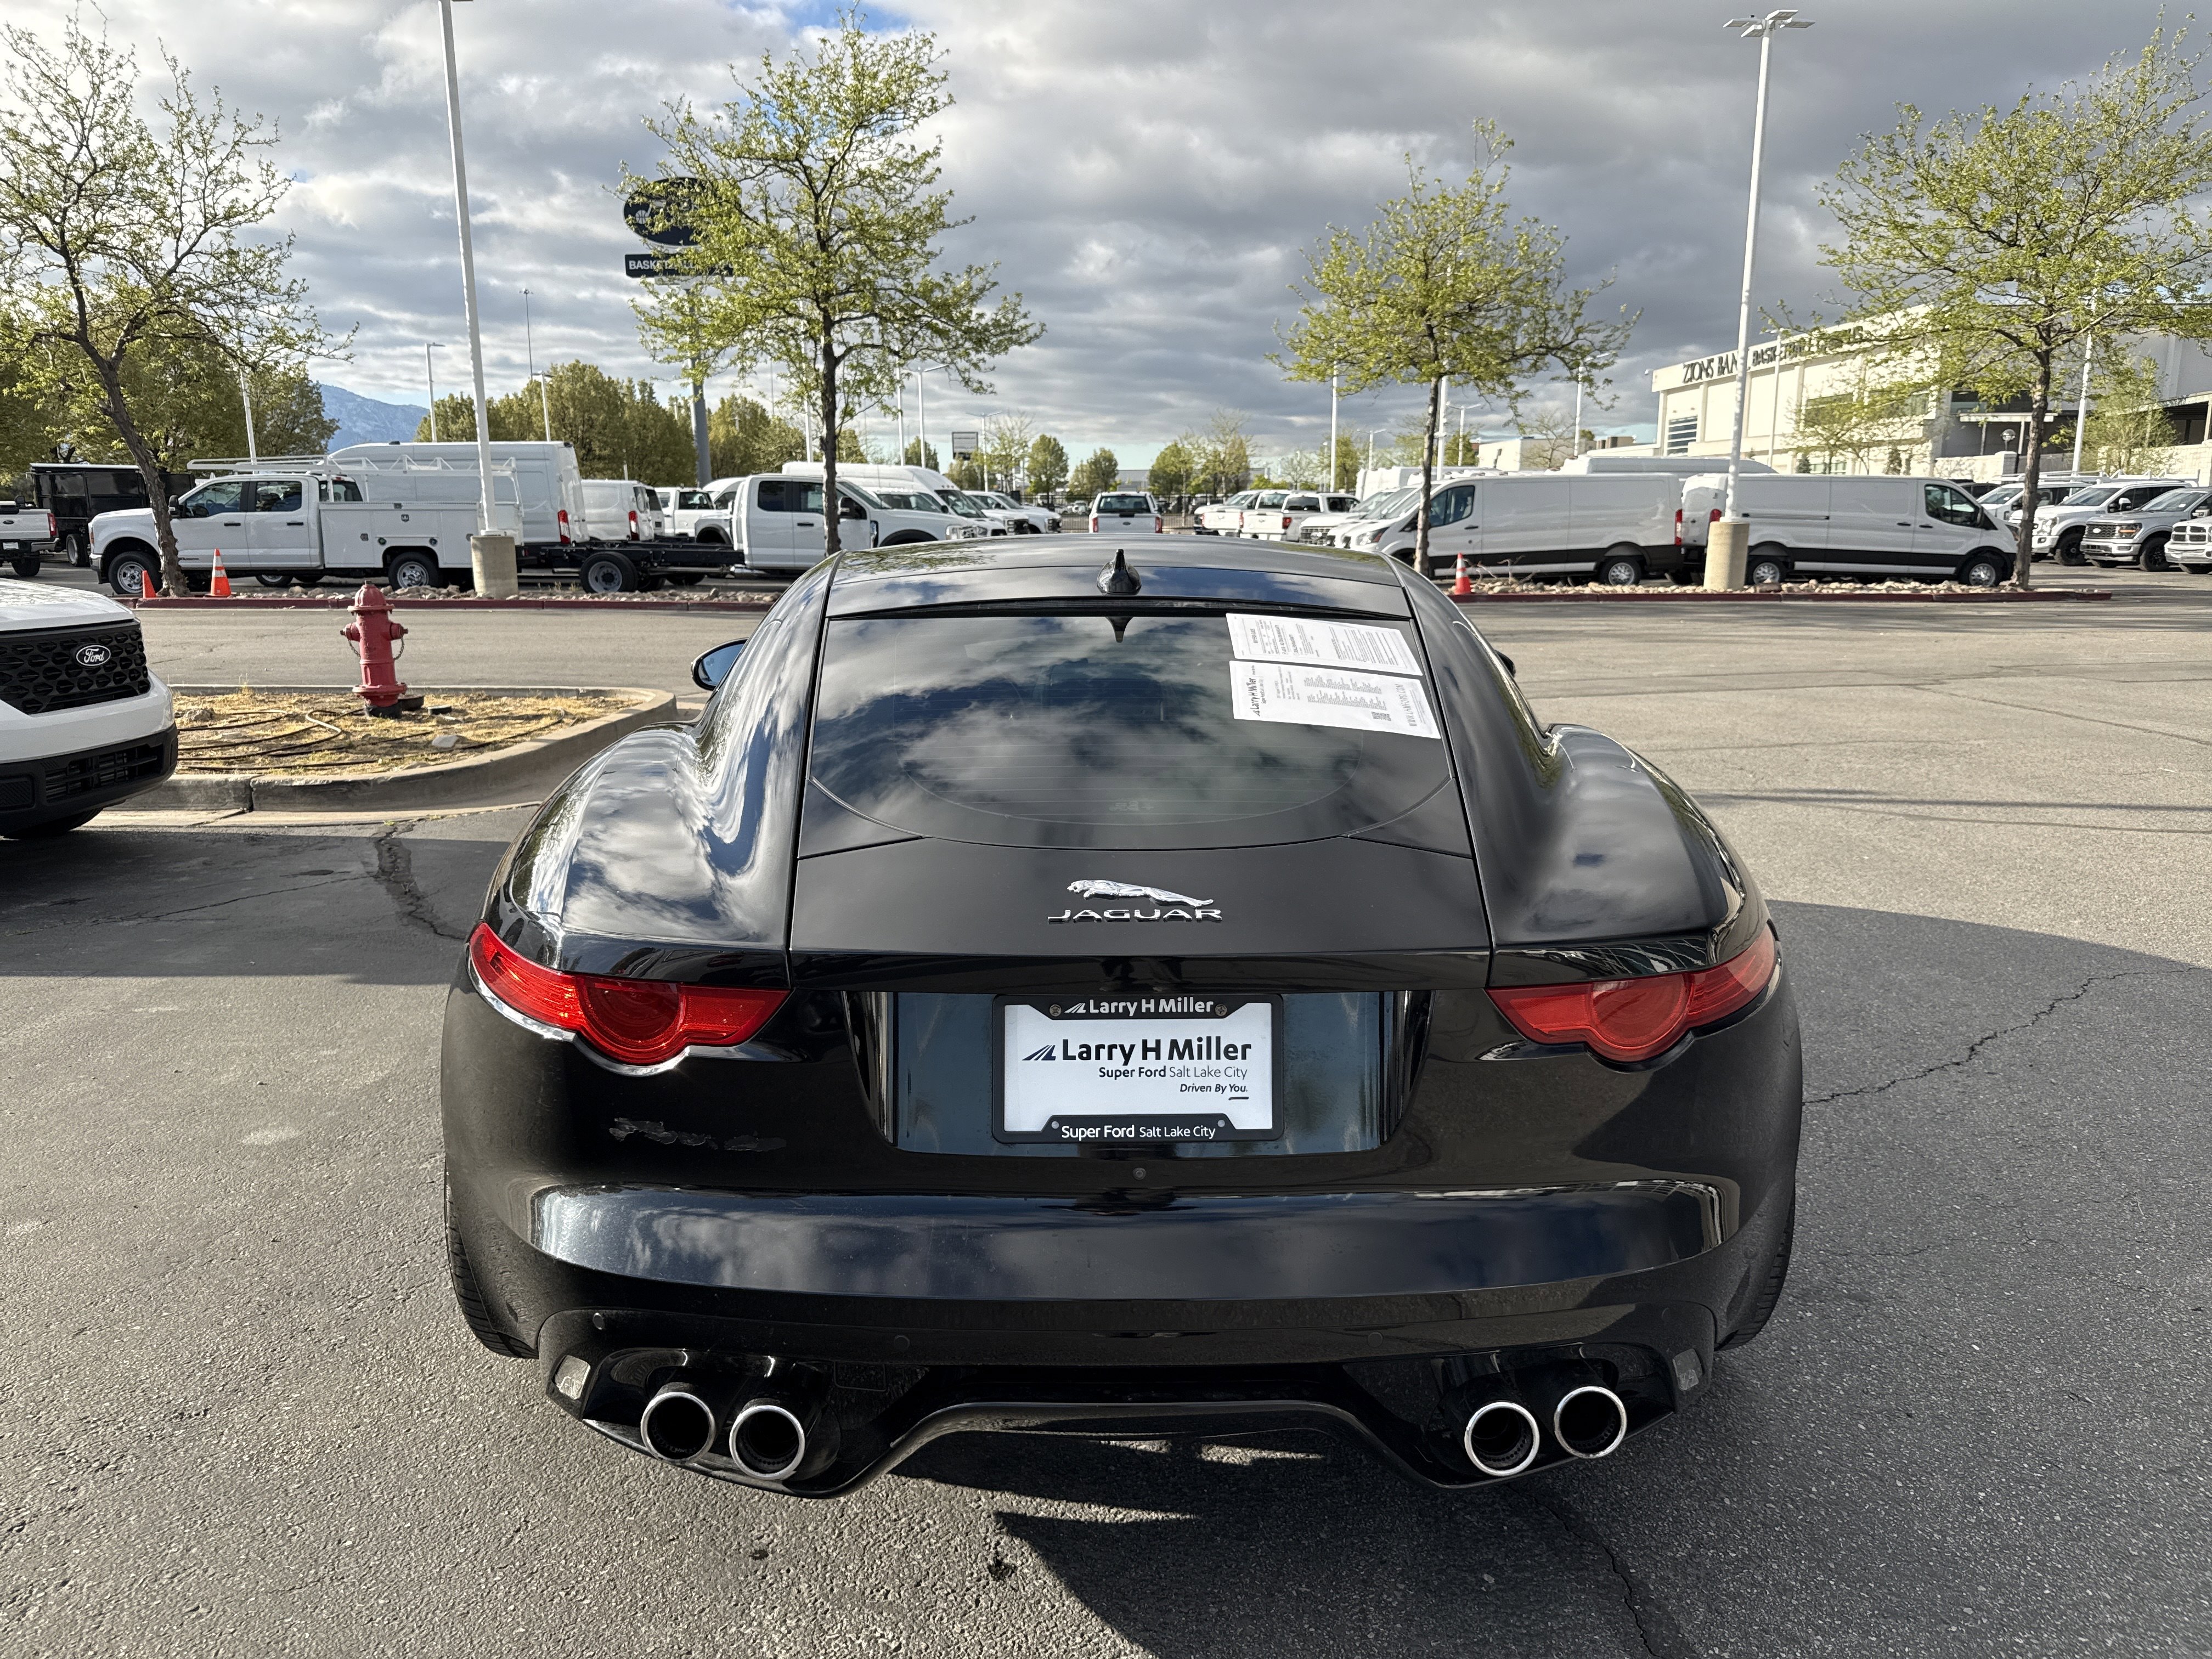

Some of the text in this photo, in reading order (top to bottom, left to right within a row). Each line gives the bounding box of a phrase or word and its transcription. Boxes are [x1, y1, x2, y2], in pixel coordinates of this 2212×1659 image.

[1682, 358, 1714, 384] ZIONS
[1717, 352, 1751, 377] BAN
[83, 648, 105, 663] Ford
[1246, 678, 1257, 692] Miller
[1250, 697, 1261, 709] Larry
[1395, 684, 1417, 726] WWW.LHMFORD.COM
[1047, 909, 1222, 923] JAGUAR
[1090, 996, 1214, 1017] Larry H Miller
[1062, 1036, 1252, 1066] Larry H Miller
[1099, 1066, 1248, 1081] Super Ford Salt Lake City
[1180, 1083, 1212, 1093] Driven
[1215, 1084, 1227, 1094] By
[1061, 1124, 1216, 1141] Super Ford Salt Lake City
